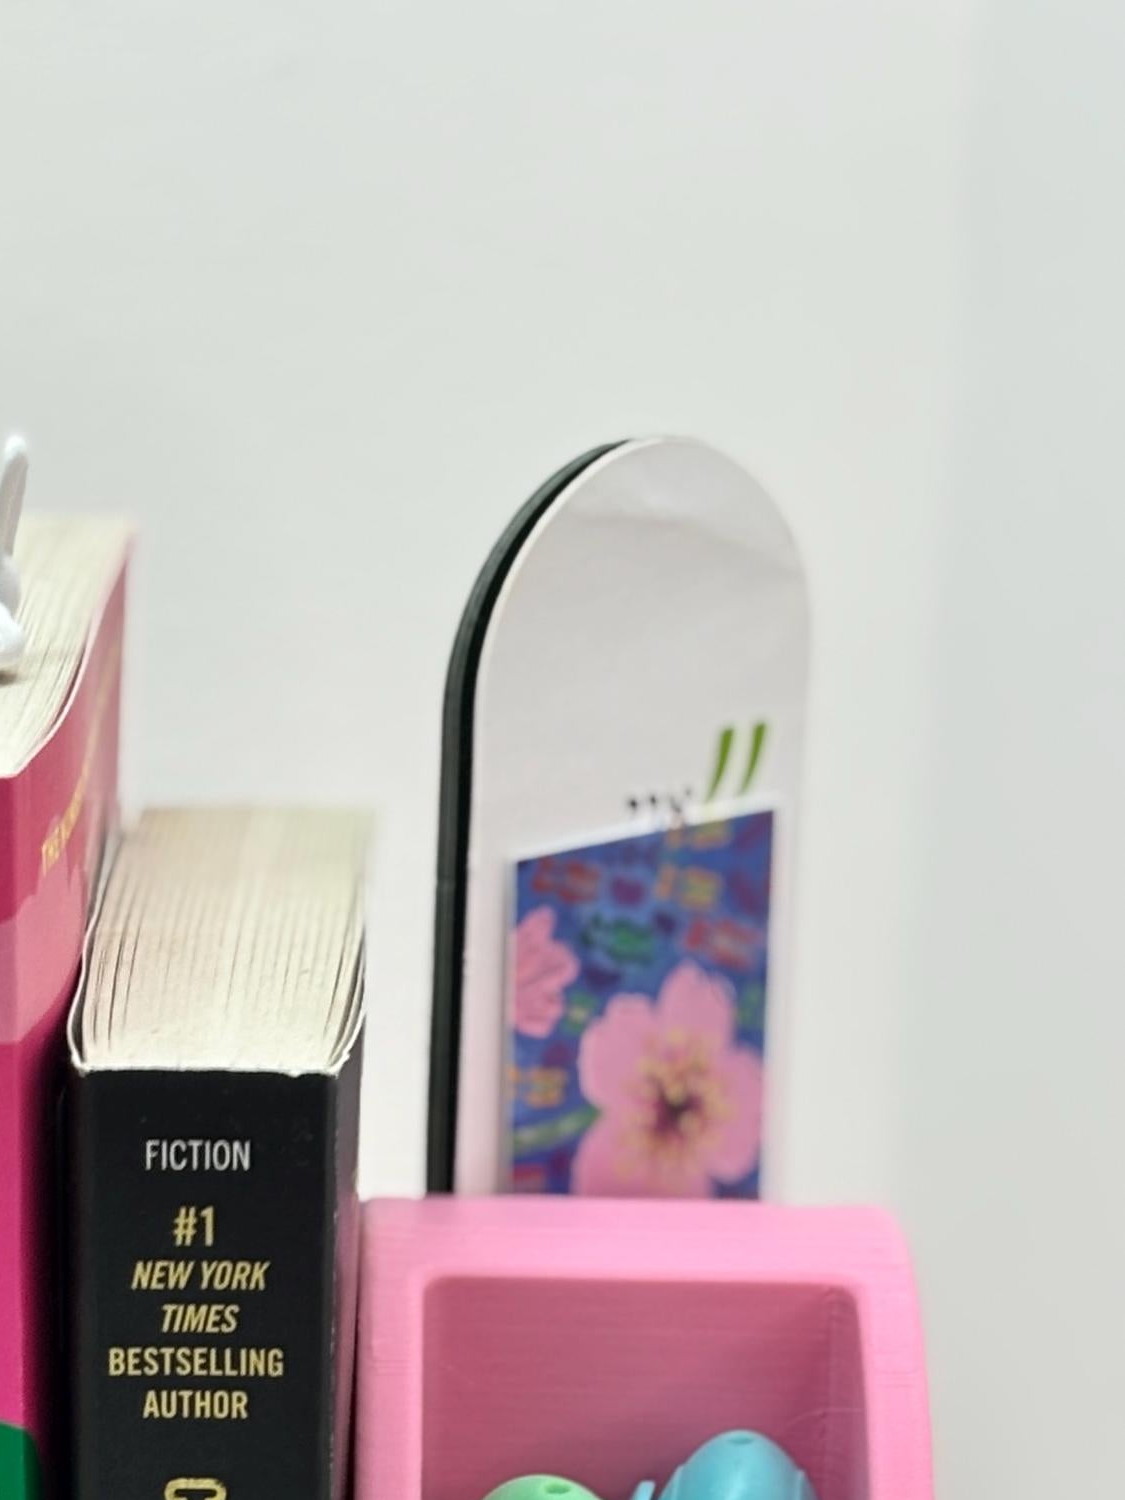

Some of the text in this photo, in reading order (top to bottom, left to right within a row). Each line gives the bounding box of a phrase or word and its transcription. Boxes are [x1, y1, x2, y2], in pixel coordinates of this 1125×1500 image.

[145, 1139, 251, 1171] FICTION
[173, 1206, 215, 1247] #1
[131, 1260, 270, 1291] NEW YORK
[161, 1303, 240, 1334] TIMES
[108, 1347, 284, 1378] BESTSELLING
[142, 1389, 249, 1419] AUTHOR
